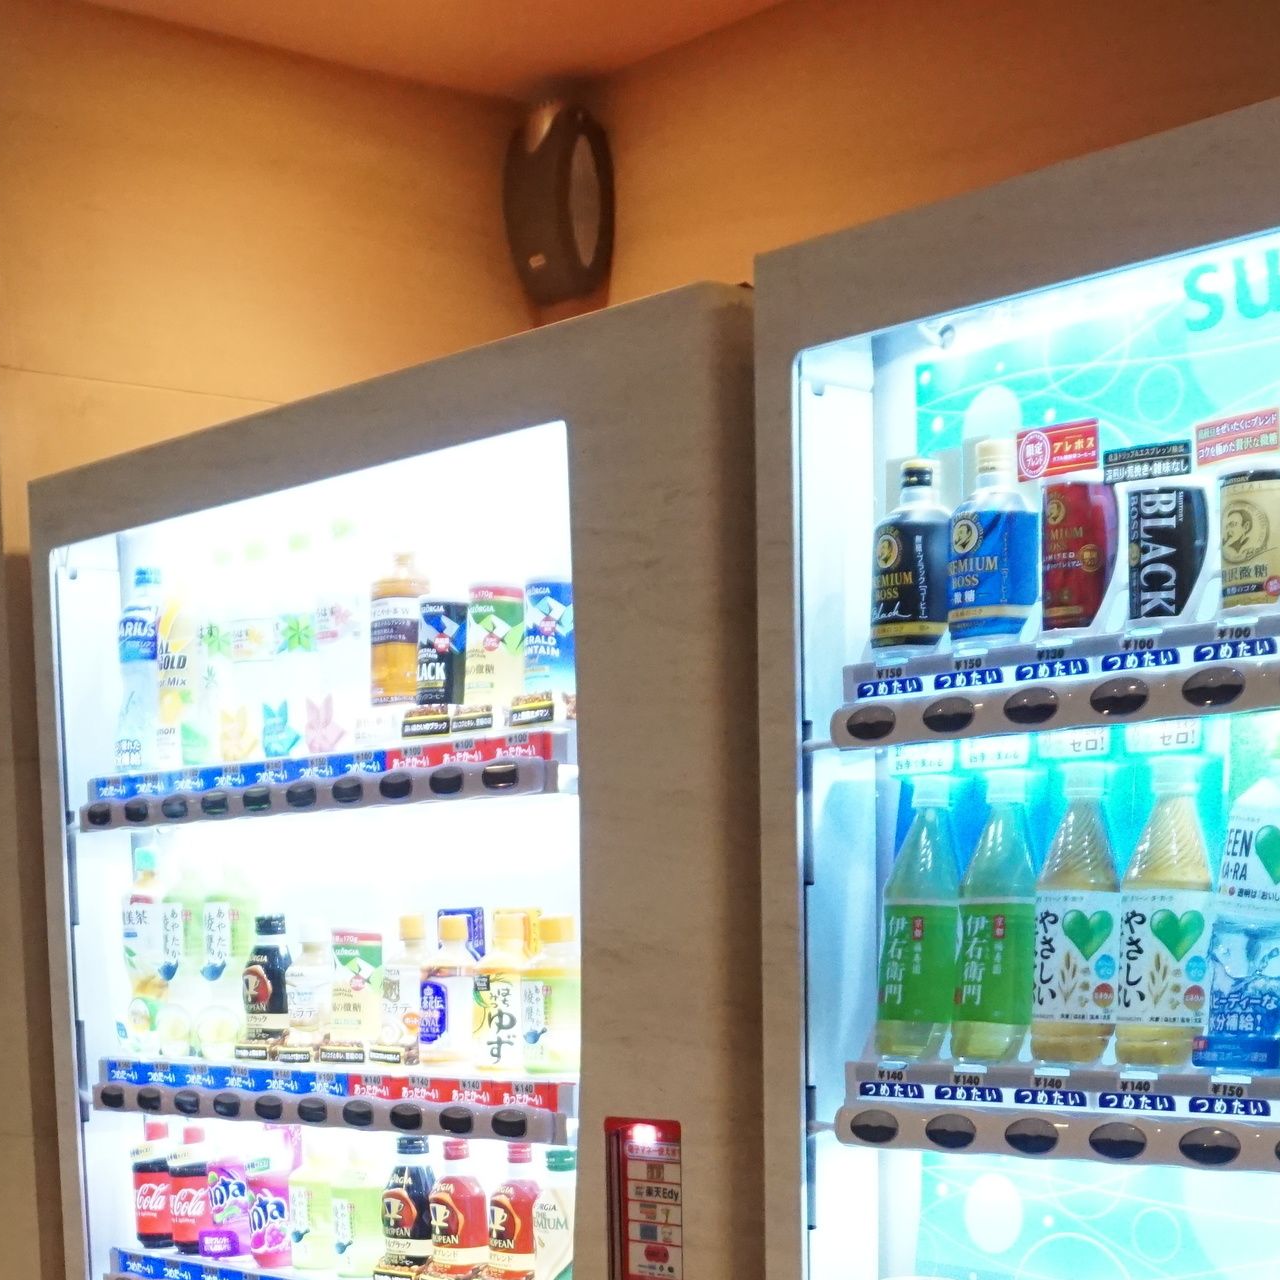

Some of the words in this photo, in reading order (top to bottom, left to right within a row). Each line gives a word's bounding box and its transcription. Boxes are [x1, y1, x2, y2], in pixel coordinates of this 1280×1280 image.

[1140, 488, 1177, 619] BLACK
[1201, 640, 1270, 658] つめたい
[1020, 659, 1083, 677] つめたい
[1108, 651, 1173, 670] つめたい
[885, 915, 908, 1006] 伊右衛門
[962, 914, 989, 1006] 伊右衛門
[1039, 909, 1059, 1006] やさしい
[1125, 910, 1146, 1008] やさしい
[487, 1011, 517, 1065] ゆず
[878, 1069, 904, 1081] ¥140
[953, 1073, 980, 1086] ¥140
[1033, 1077, 1063, 1089] ¥140
[865, 1083, 919, 1098] つめたい
[1120, 1080, 1151, 1092] ¥140
[1211, 1084, 1244, 1097] ¥150
[1195, 1099, 1263, 1115] つめたい
